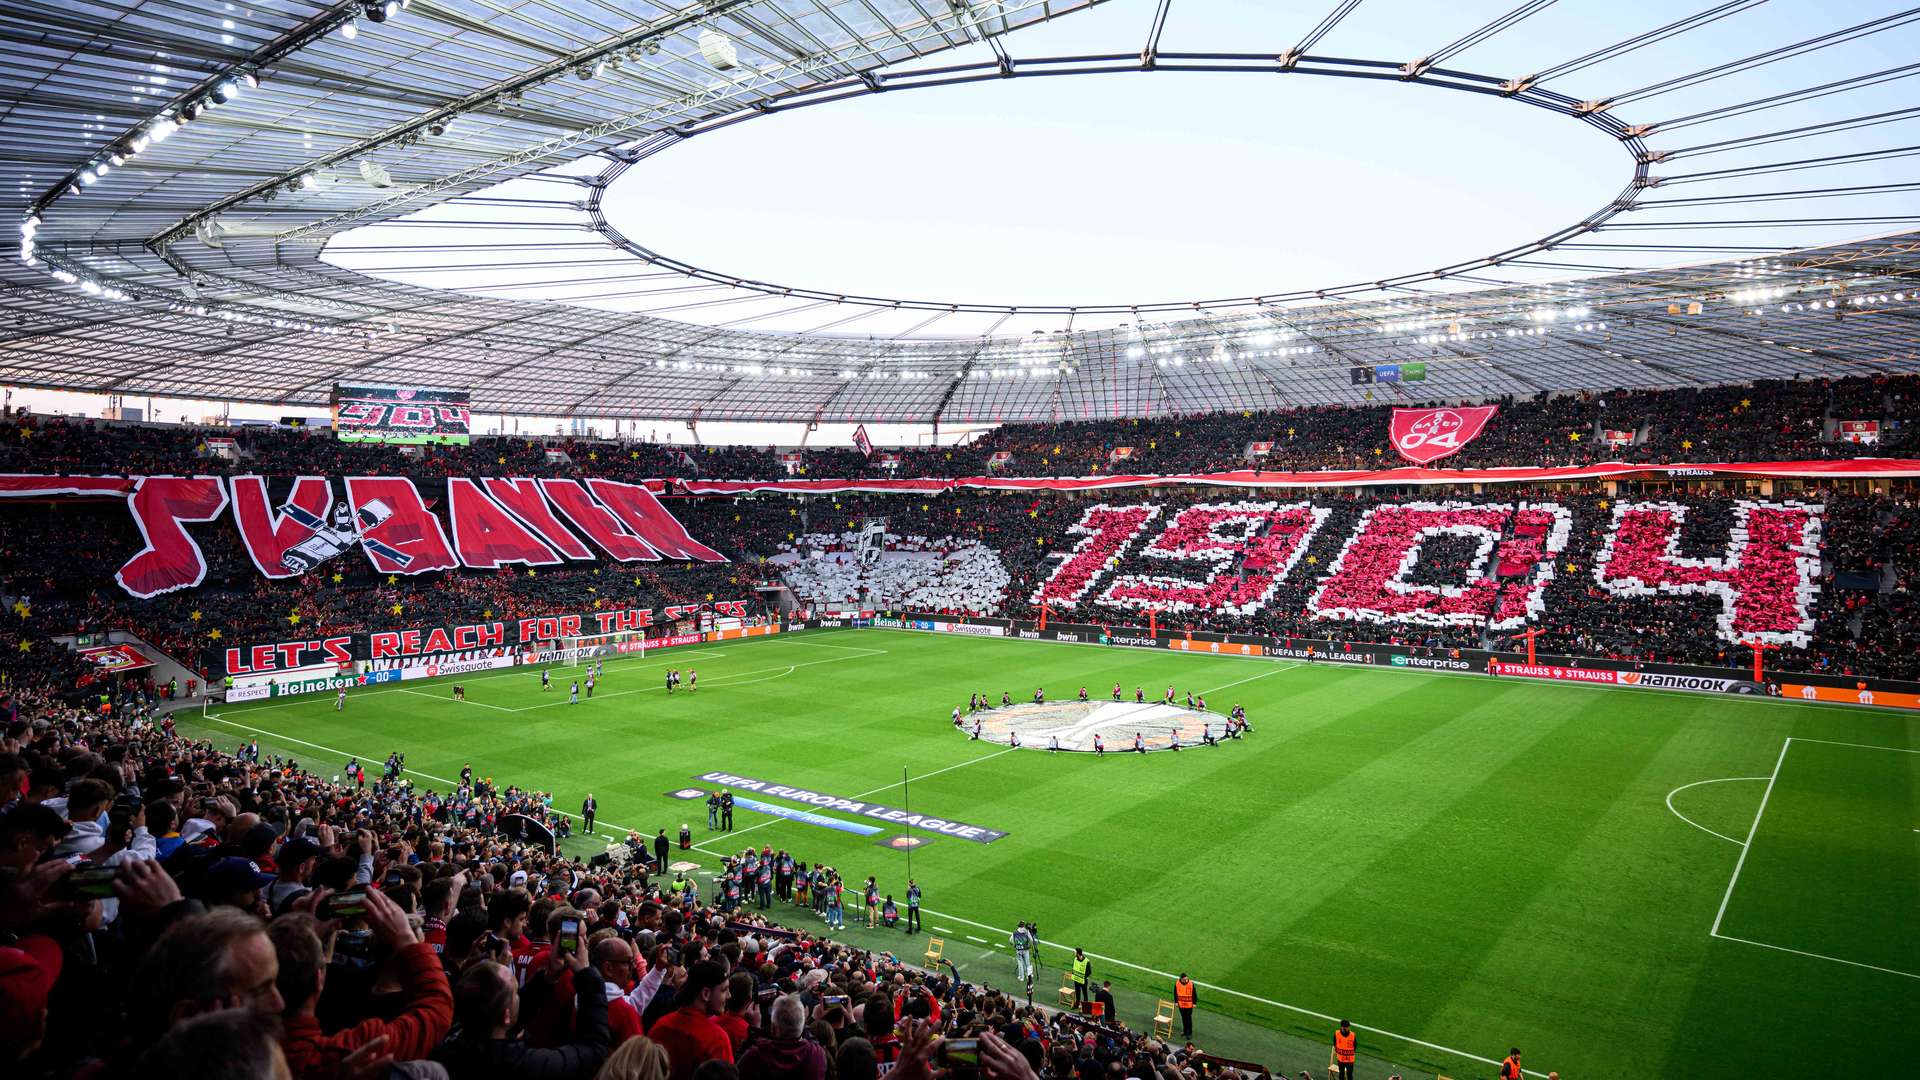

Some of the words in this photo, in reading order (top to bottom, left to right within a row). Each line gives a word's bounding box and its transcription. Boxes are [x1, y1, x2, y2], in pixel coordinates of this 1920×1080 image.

[1400, 431, 1460, 449] 04
[1676, 468, 1714, 476] STRAUSS
[1033, 500, 1826, 648] 1904
[788, 622, 805, 632] bwin
[820, 619, 842, 628] bwin
[954, 623, 992, 636] Swissquote
[1019, 629, 1040, 639] bwin
[1056, 631, 1078, 642] bwin
[225, 636, 352, 675] LET'S
[370, 622, 504, 659] REACH
[519, 614, 583, 643] FOR
[595, 609, 654, 633] THE
[629, 640, 660, 650] STRAUSS
[671, 635, 699, 645] STRAUSS
[1272, 648, 1294, 657] UEFA
[1329, 652, 1363, 662] LEAGUE
[1392, 655, 1470, 670] enterprise
[439, 659, 493, 675] Swissquote
[1504, 665, 1550, 676] STRAUSS
[1566, 670, 1614, 681] STRAUSS
[277, 676, 354, 697] Heineken
[376, 672, 389, 682] 0.0
[237, 688, 268, 697] RESPECT
[702, 772, 767, 791] UEFA
[763, 786, 865, 813] EUROPA
[866, 806, 985, 838] LEAGUE
